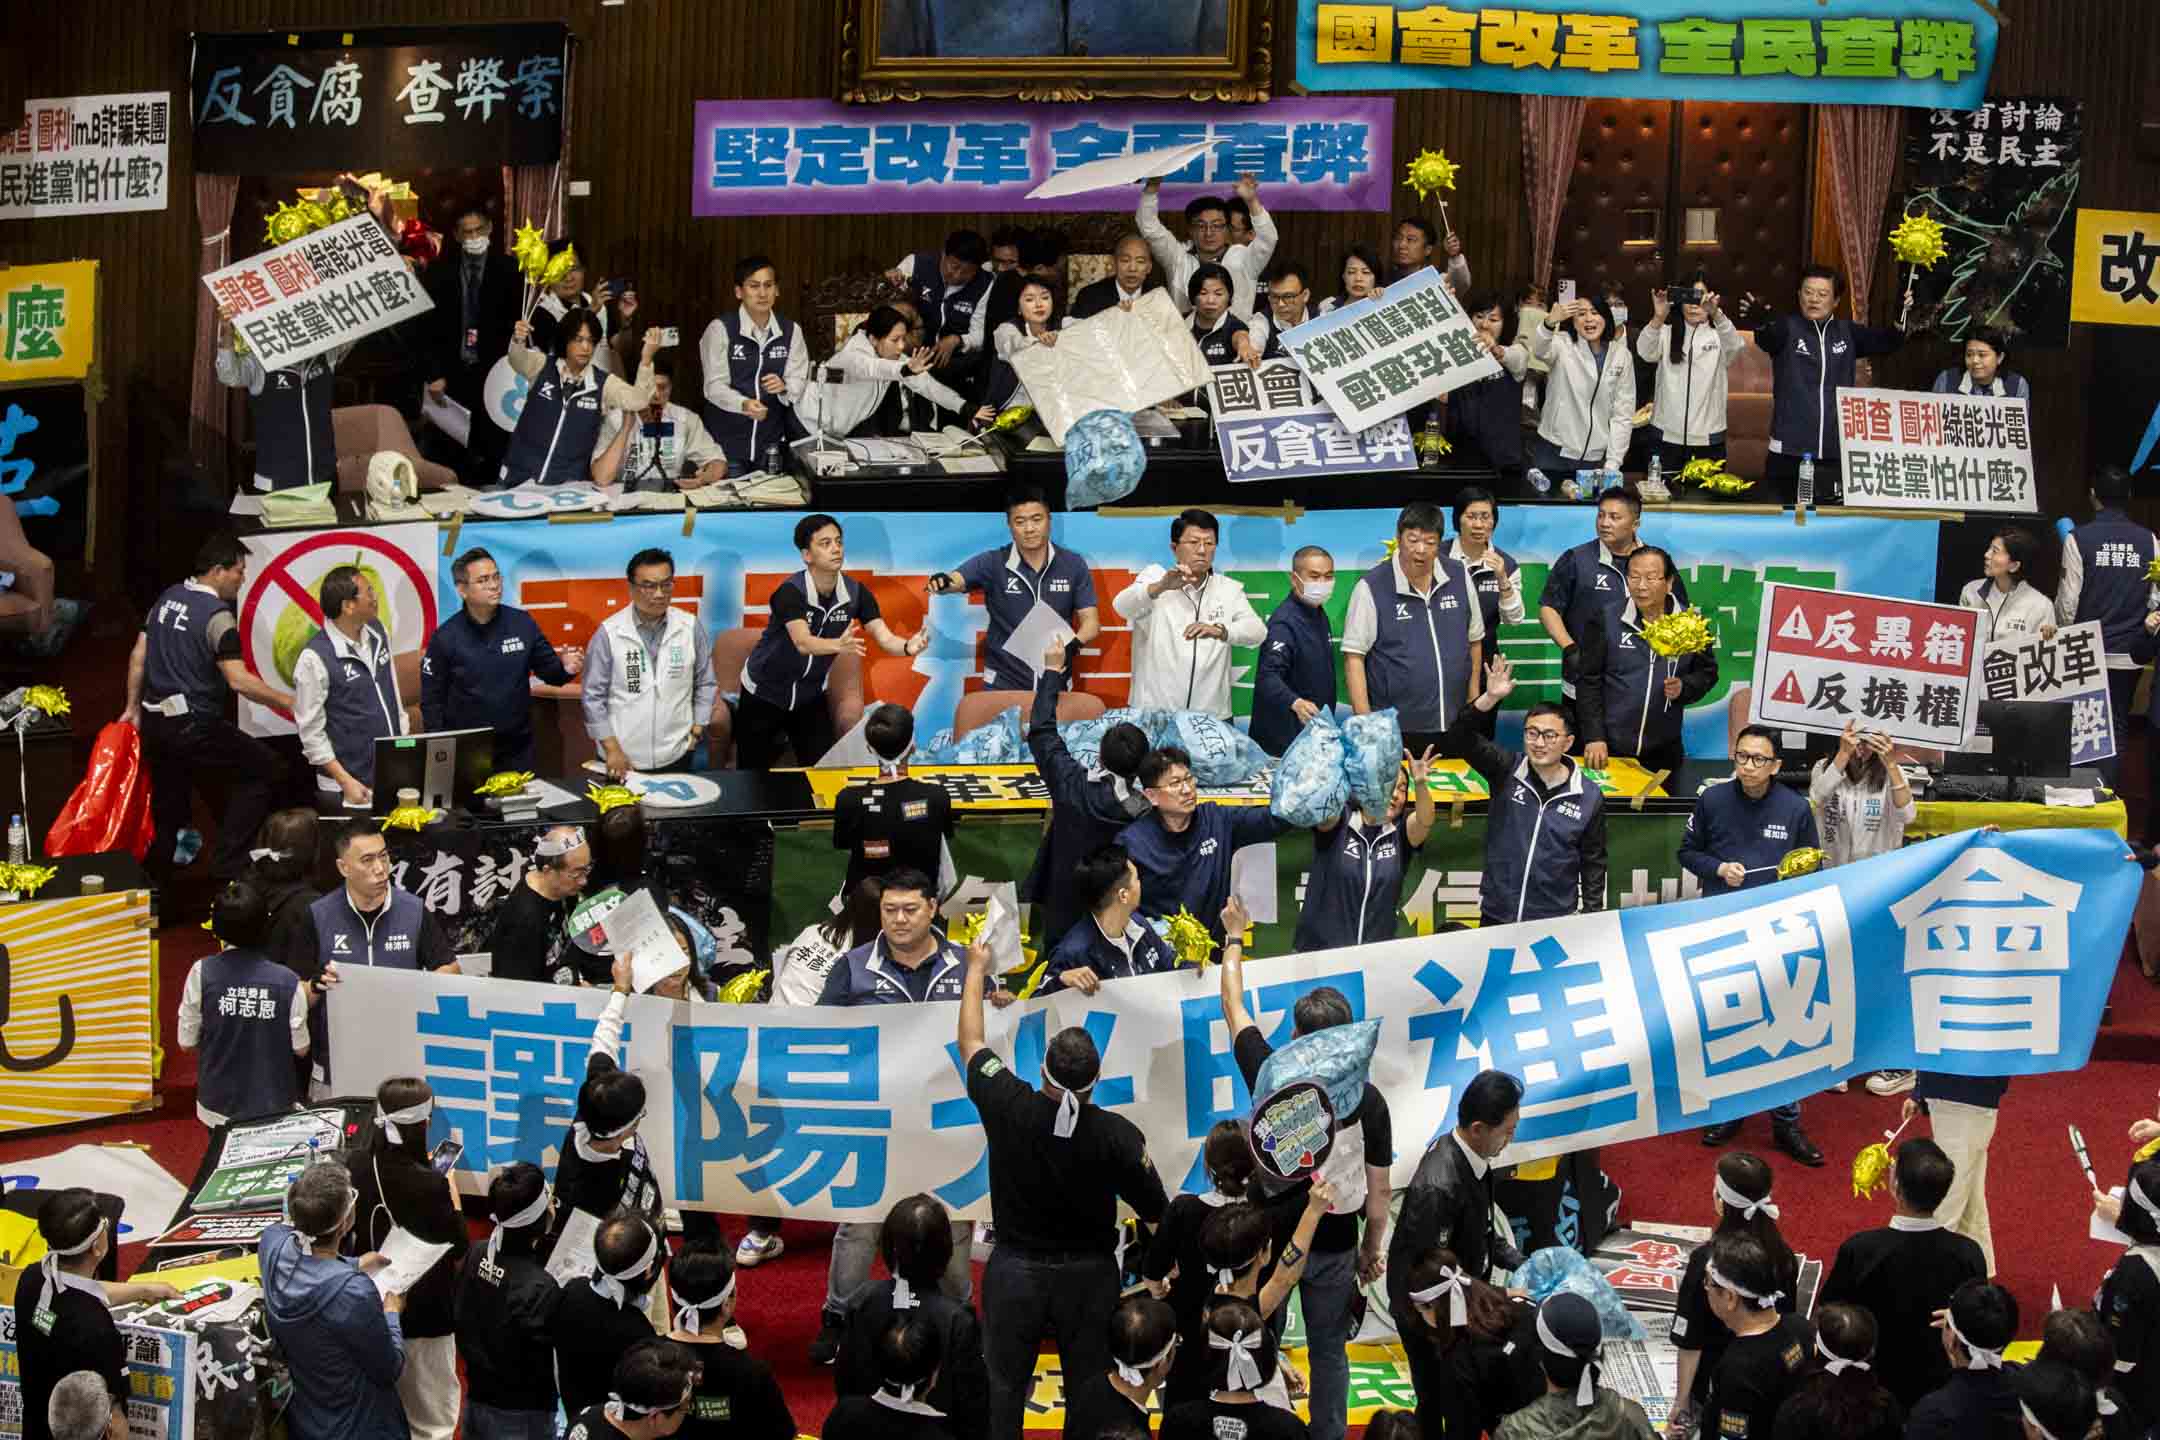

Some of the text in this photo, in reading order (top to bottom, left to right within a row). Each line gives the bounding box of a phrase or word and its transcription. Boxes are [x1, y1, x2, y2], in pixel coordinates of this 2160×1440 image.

[1316, 4, 1977, 84] 國會改革 全民查弊
[200, 53, 562, 129] 反貪腐 查弊案
[711, 122, 1031, 189] 堅定改革
[1927, 131, 2063, 167] 不是民主
[0, 155, 163, 207] 民進黨怕什麼?
[263, 221, 394, 298] 圖利綠能光電
[245, 269, 416, 359] 民進黨怕什麼?
[1215, 363, 1304, 415] 國會
[1841, 396, 2029, 450] 調查 圖利綠能光電
[1846, 450, 2029, 503] 民進黨怕什麼?
[2095, 551, 2141, 568] 羅智強
[1815, 608, 1967, 667] 反黑箱
[625, 650, 641, 694] 林國成
[1806, 670, 1961, 729] 反擴權
[391, 849, 530, 915] 有討
[218, 995, 277, 1020] 柯志恩
[226, 986, 269, 999] 立法委員
